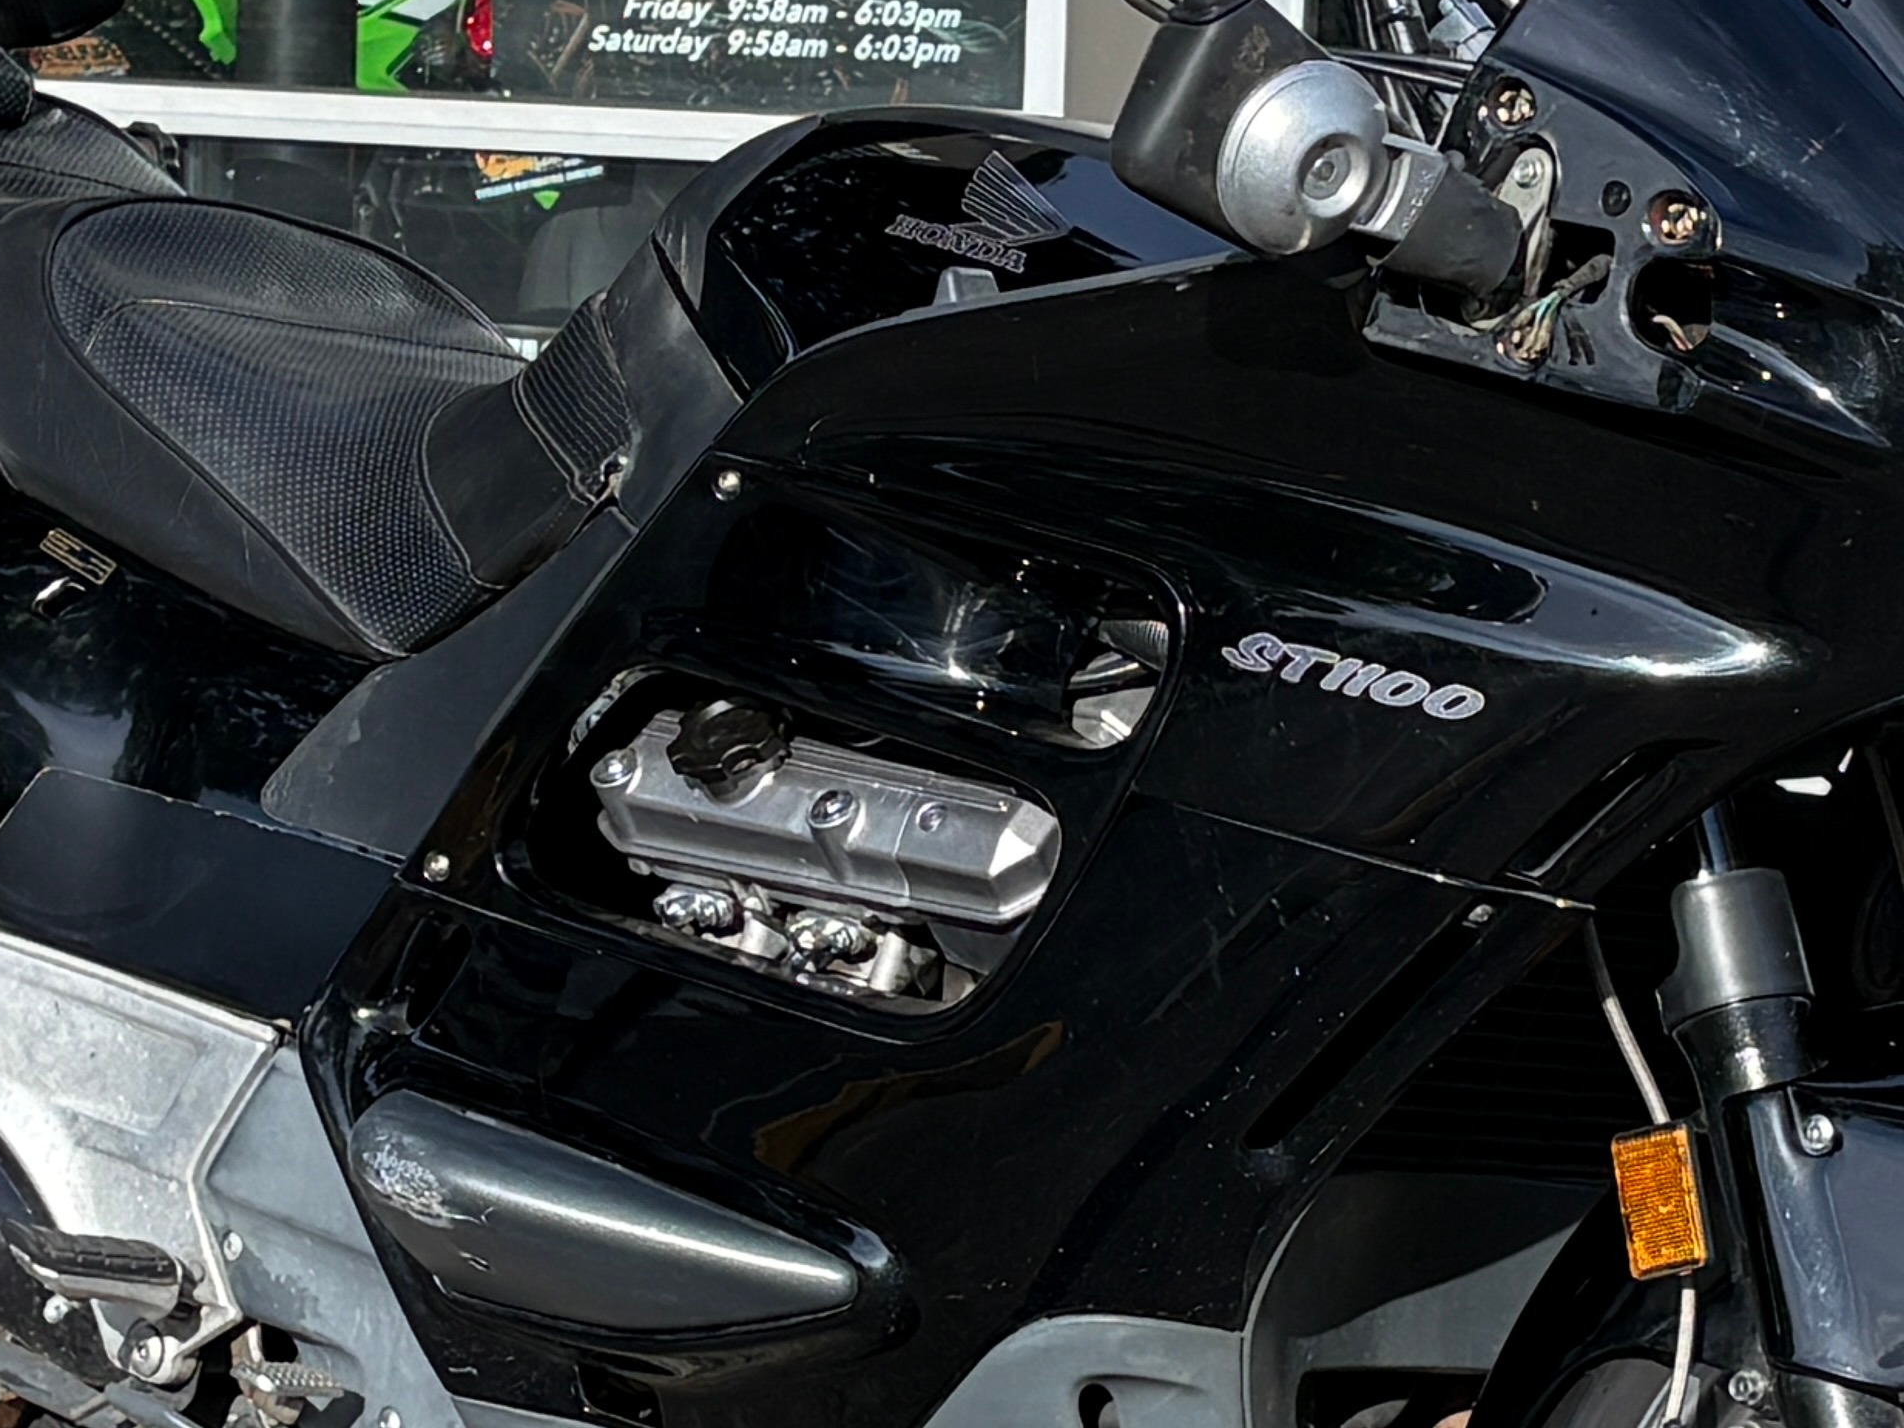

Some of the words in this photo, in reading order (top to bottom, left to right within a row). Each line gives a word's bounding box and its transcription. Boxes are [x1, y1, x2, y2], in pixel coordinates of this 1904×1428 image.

[589, 25, 712, 56] Saturday
[727, 29, 827, 58] 9:58am
[854, 33, 961, 67] 6:03pm
[884, 215, 1026, 273] HONDA
[1221, 632, 1486, 721] ST1100
